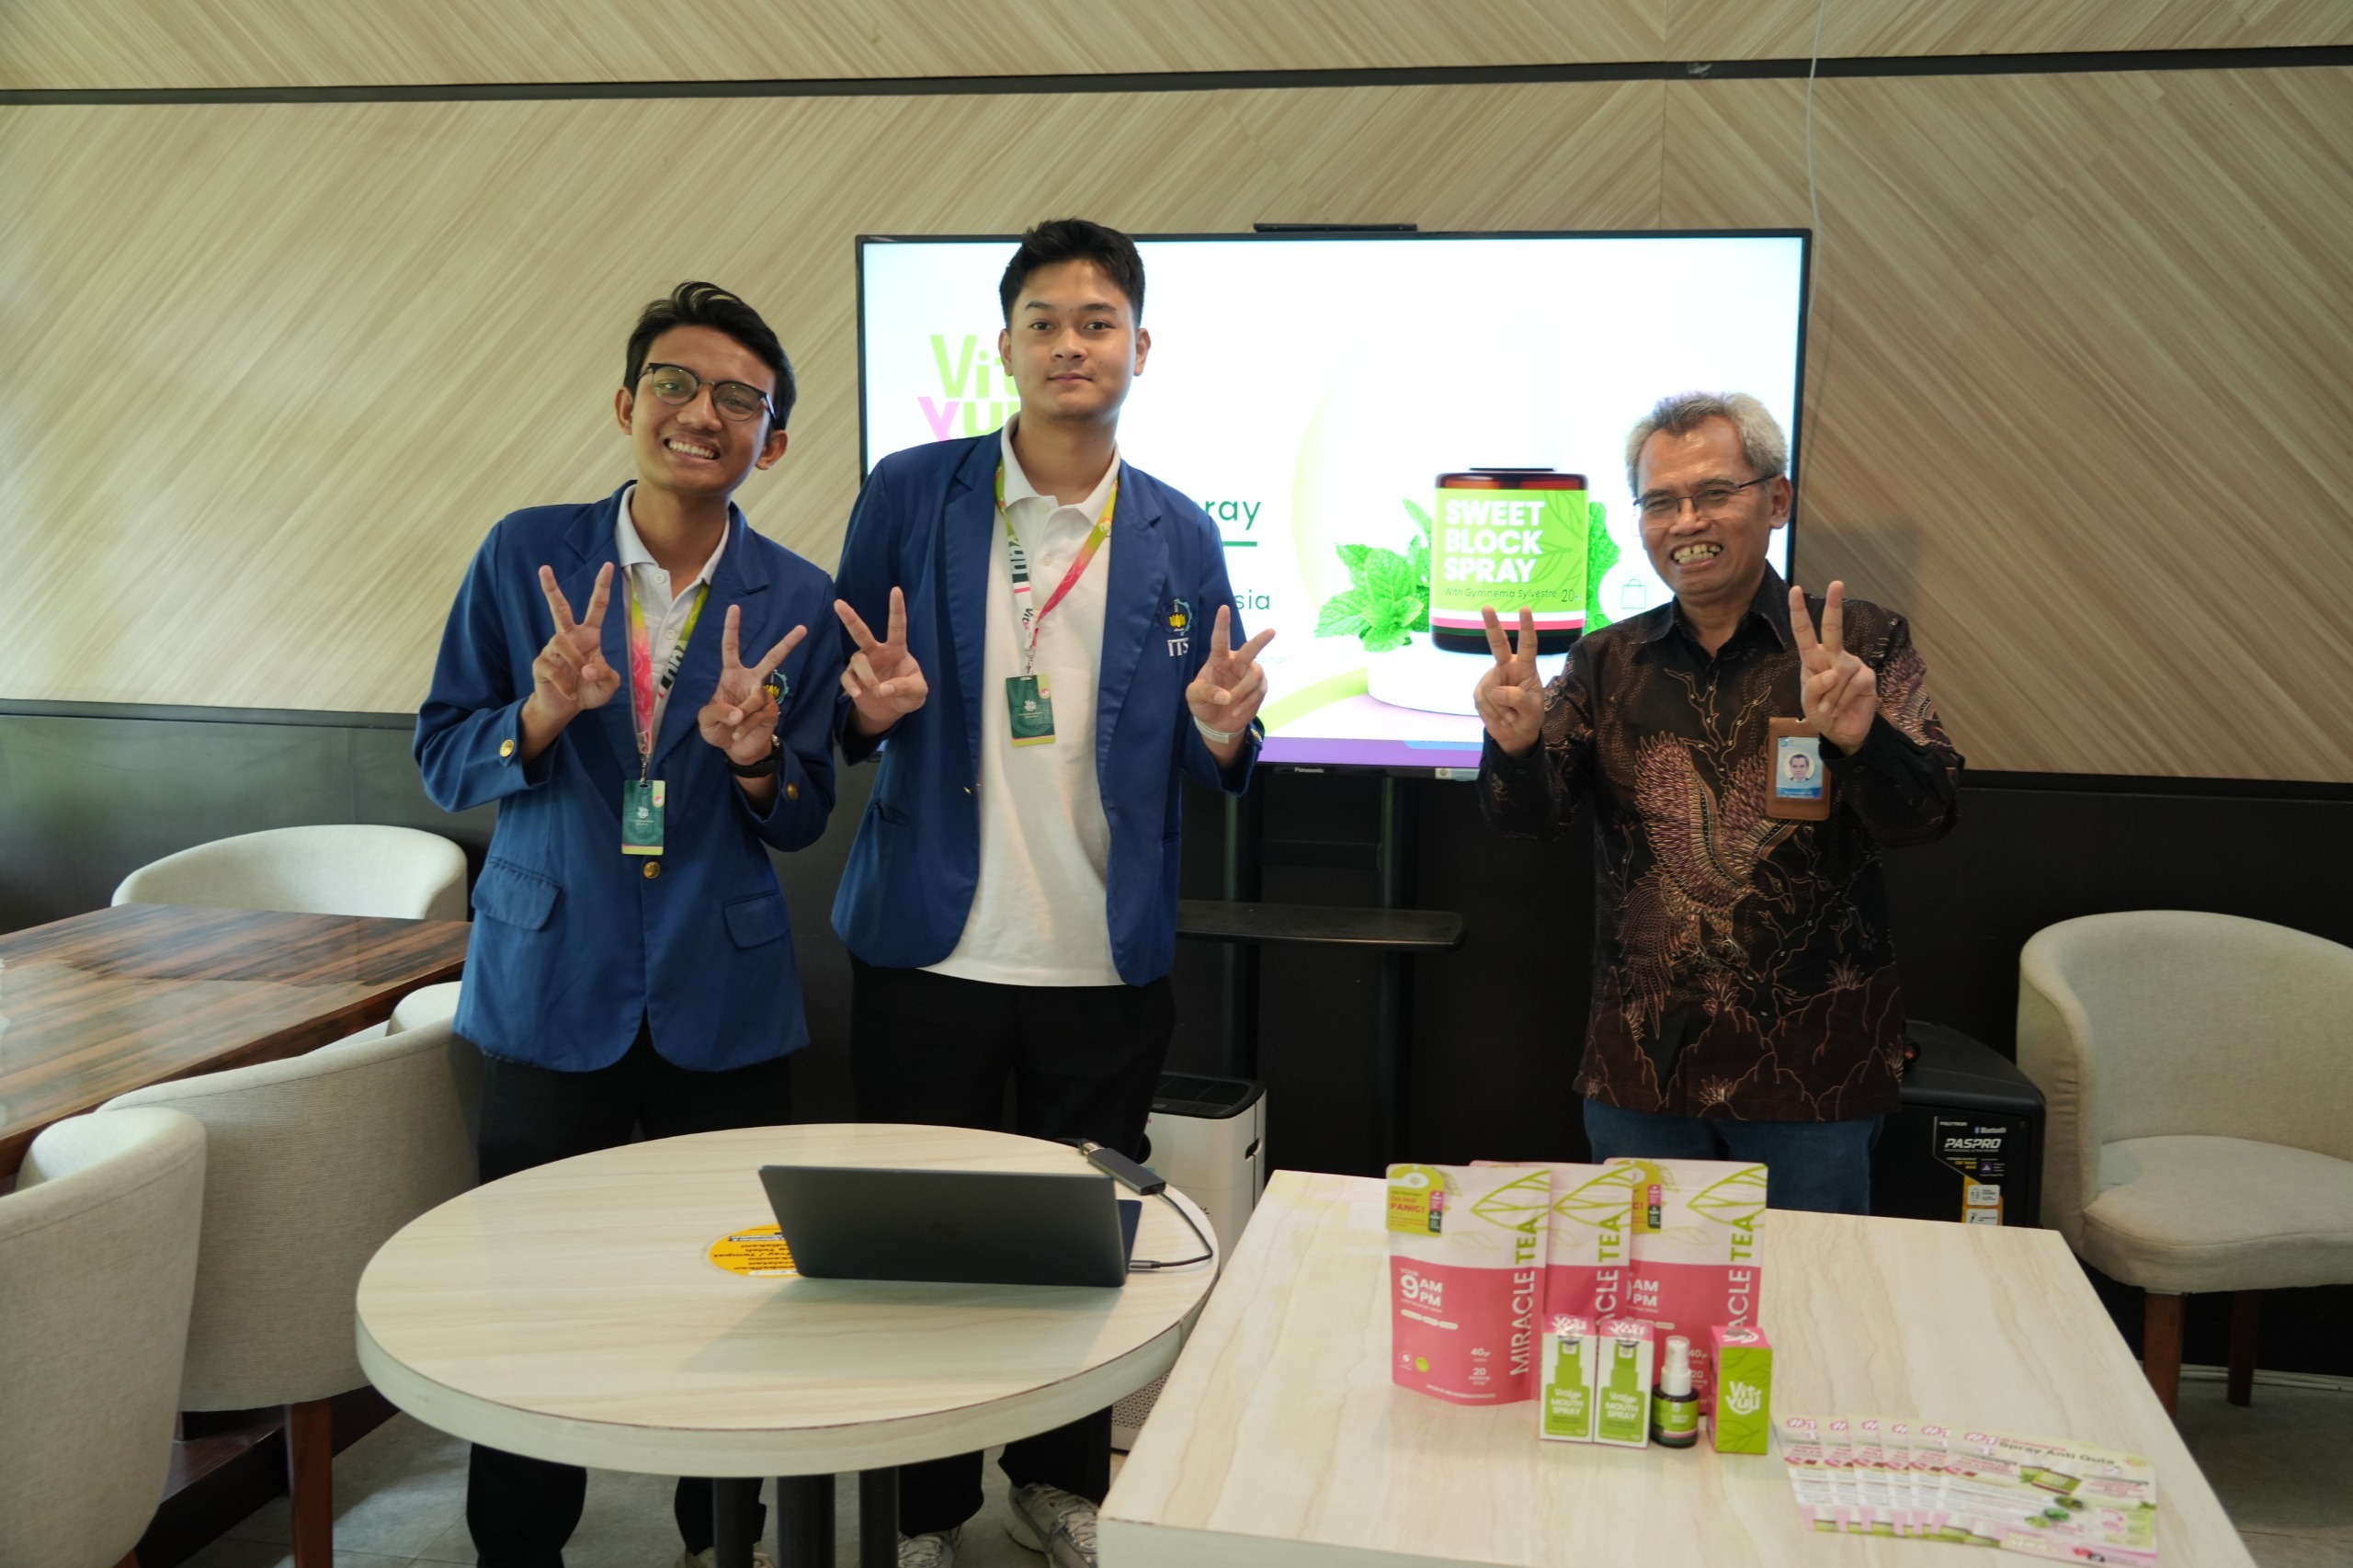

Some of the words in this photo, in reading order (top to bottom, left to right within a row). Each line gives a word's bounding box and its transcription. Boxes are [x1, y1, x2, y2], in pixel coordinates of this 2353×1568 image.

[1205, 501, 1261, 530] ray
[1445, 499, 1546, 527] SWEET
[1445, 528, 1543, 555] BLOCK
[1444, 557, 1537, 583] SPRAY
[1445, 587, 1463, 597] With
[1465, 588, 1516, 599] Gymnema
[1518, 589, 1557, 600] Sylvestre
[1166, 637, 1190, 657] ITS
[1944, 1138, 2002, 1149] PASPRO
[1391, 1203, 1426, 1213] PANIC!
[1515, 1218, 1538, 1265] TEA
[1597, 1214, 1620, 1262] TEA
[1730, 1215, 1755, 1262] TEA
[1401, 1274, 1419, 1299] 9
[1419, 1278, 1443, 1293] AM
[1632, 1278, 1659, 1292] AM
[1420, 1291, 1441, 1307] PM
[1632, 1293, 1657, 1307] PM
[1509, 1271, 1535, 1376] MIRACLE
[1472, 1367, 1486, 1376] 20
[1691, 1370, 1703, 1379] 20
[1551, 1398, 1584, 1407] MOUTH
[1552, 1406, 1581, 1415] SPRAY
[1605, 1403, 1639, 1412] MOUTH
[1608, 1411, 1636, 1420] SPRAY
[1998, 1441, 2042, 1456] Spray
[2045, 1449, 2076, 1460] Anti
